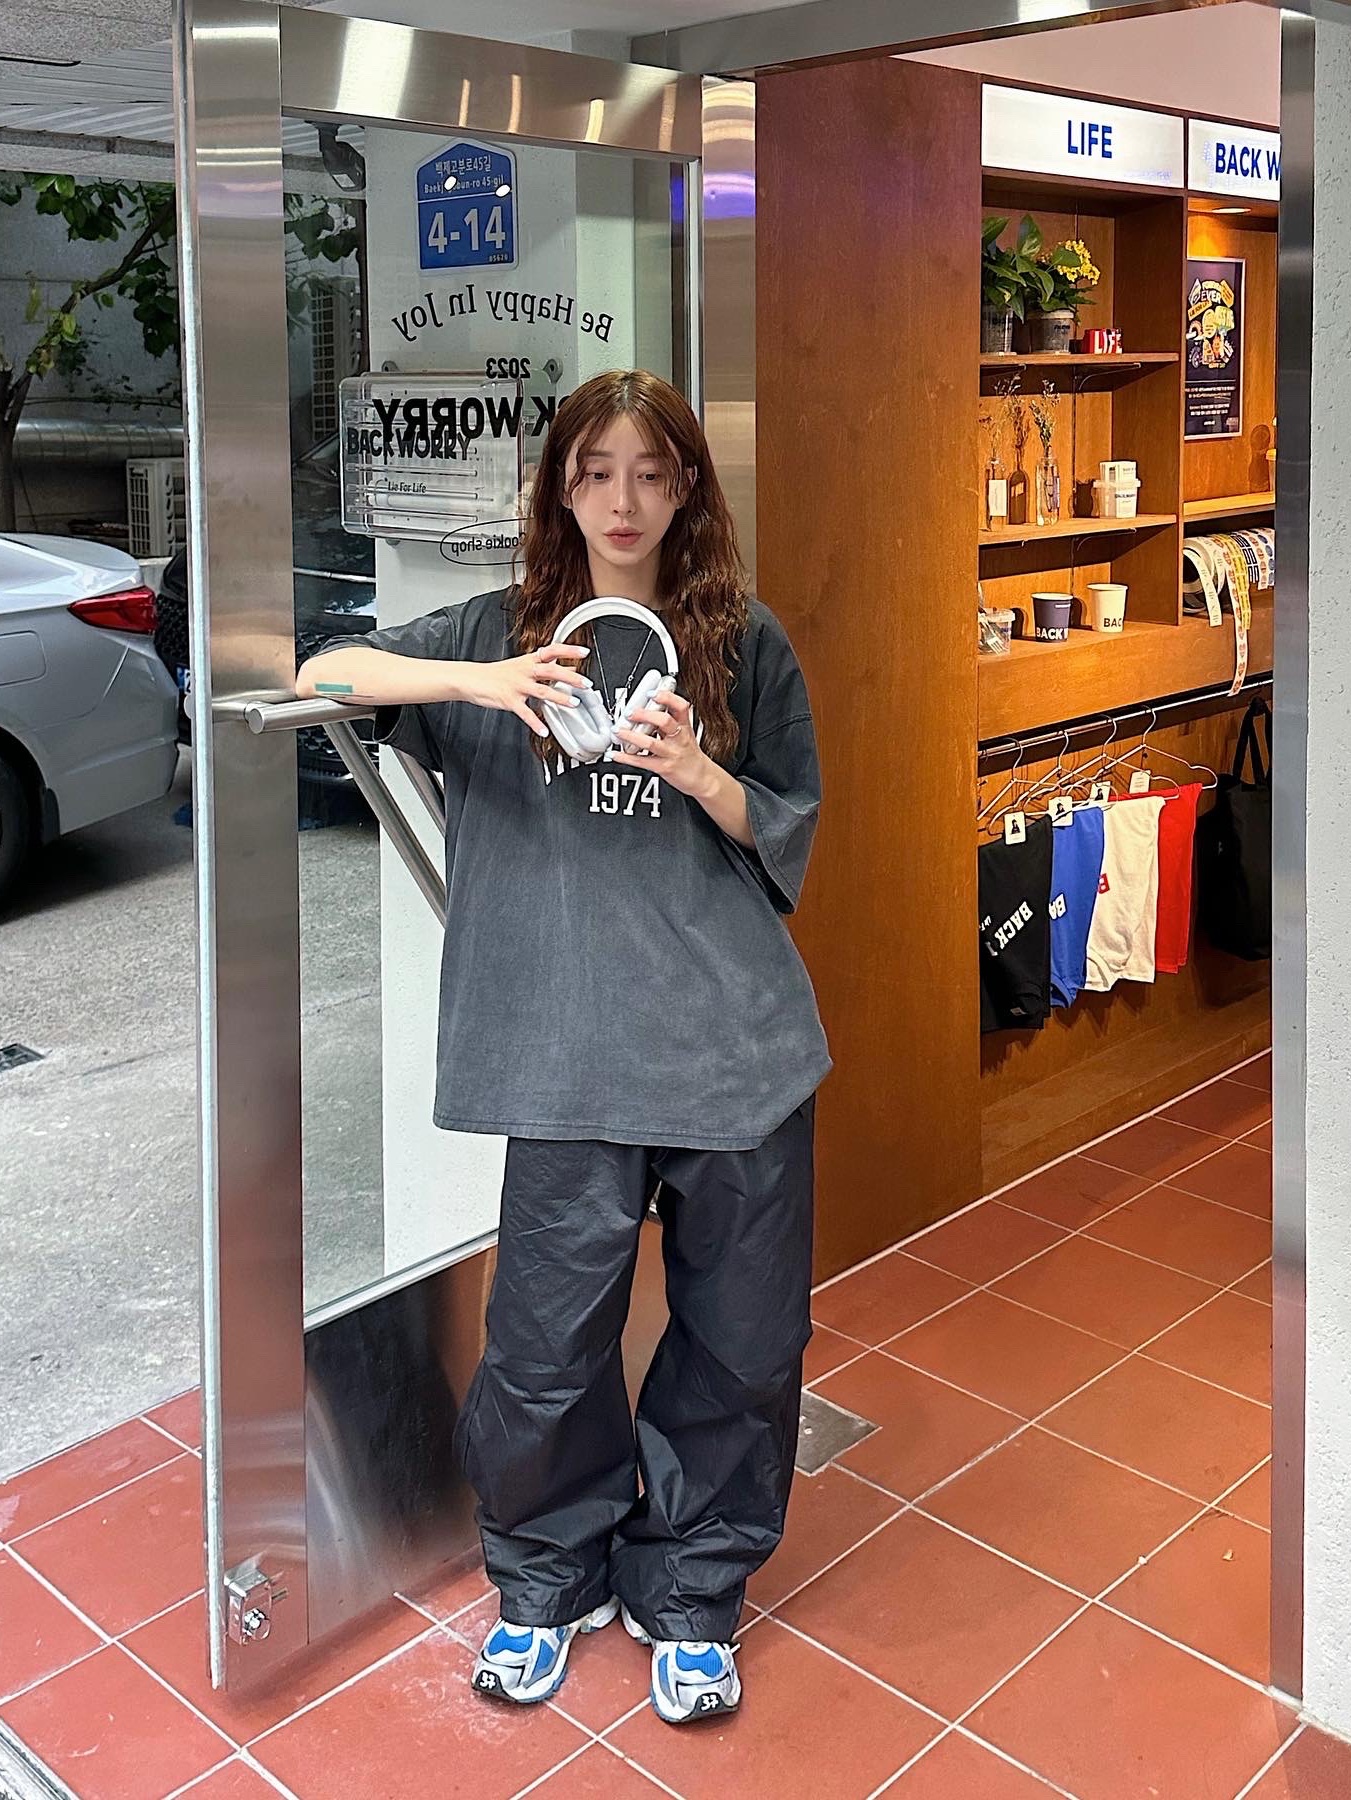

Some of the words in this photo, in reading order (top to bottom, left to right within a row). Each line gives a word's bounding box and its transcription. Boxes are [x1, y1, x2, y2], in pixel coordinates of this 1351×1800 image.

[1067, 119, 1112, 158] LIFE
[435, 155, 491, 177] 백제고분로45길
[1215, 142, 1261, 178] BACK
[427, 206, 506, 253] 4-14
[1094, 330, 1123, 354] LIFE
[347, 427, 394, 458] BACK
[412, 483, 427, 493] Life
[589, 772, 661, 818] 1974
[994, 901, 1033, 950] BACK
